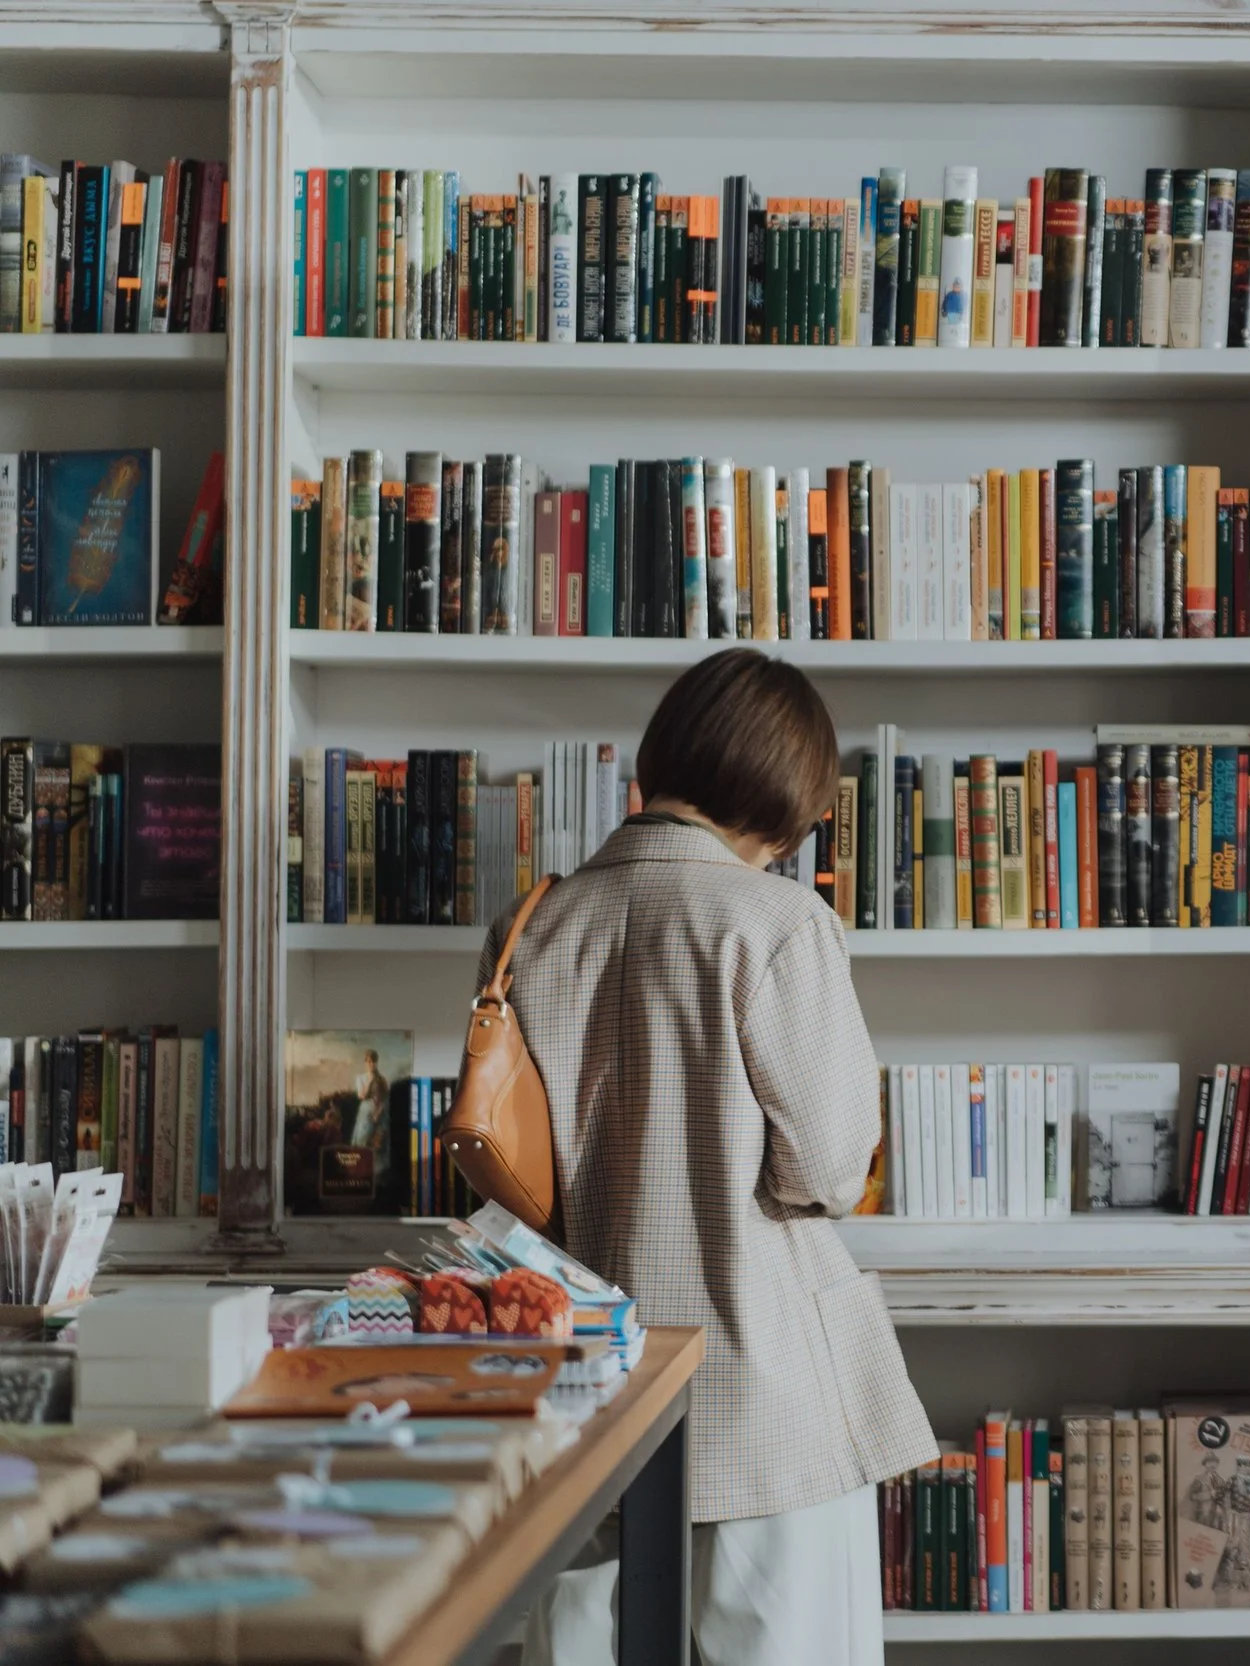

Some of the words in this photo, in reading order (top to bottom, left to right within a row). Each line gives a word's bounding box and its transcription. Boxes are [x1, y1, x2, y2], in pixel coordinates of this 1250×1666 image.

[85, 180, 96, 221] ДЫМА
[980, 211, 991, 242] ГЕССЕ
[83, 227, 94, 263] ВКУС
[556, 315, 570, 328] ДЕ
[8, 754, 23, 816] ДУБЛИН
[1224, 760, 1236, 794] ДЕТИ
[520, 786, 528, 819] РЕМАРК
[840, 789, 851, 825] УАЙЛЬД
[957, 788, 969, 830] ХАКСЛИ
[1006, 786, 1018, 827] ХЕЛЛЕР
[1224, 798, 1236, 835] ОТЦА
[840, 827, 850, 855] ОСКАР
[1213, 852, 1224, 889] АРНО
[1223, 842, 1236, 890] ШМИДТ
[1134, 1071, 1159, 1080] Sartre
[1202, 1420, 1226, 1443] 12
